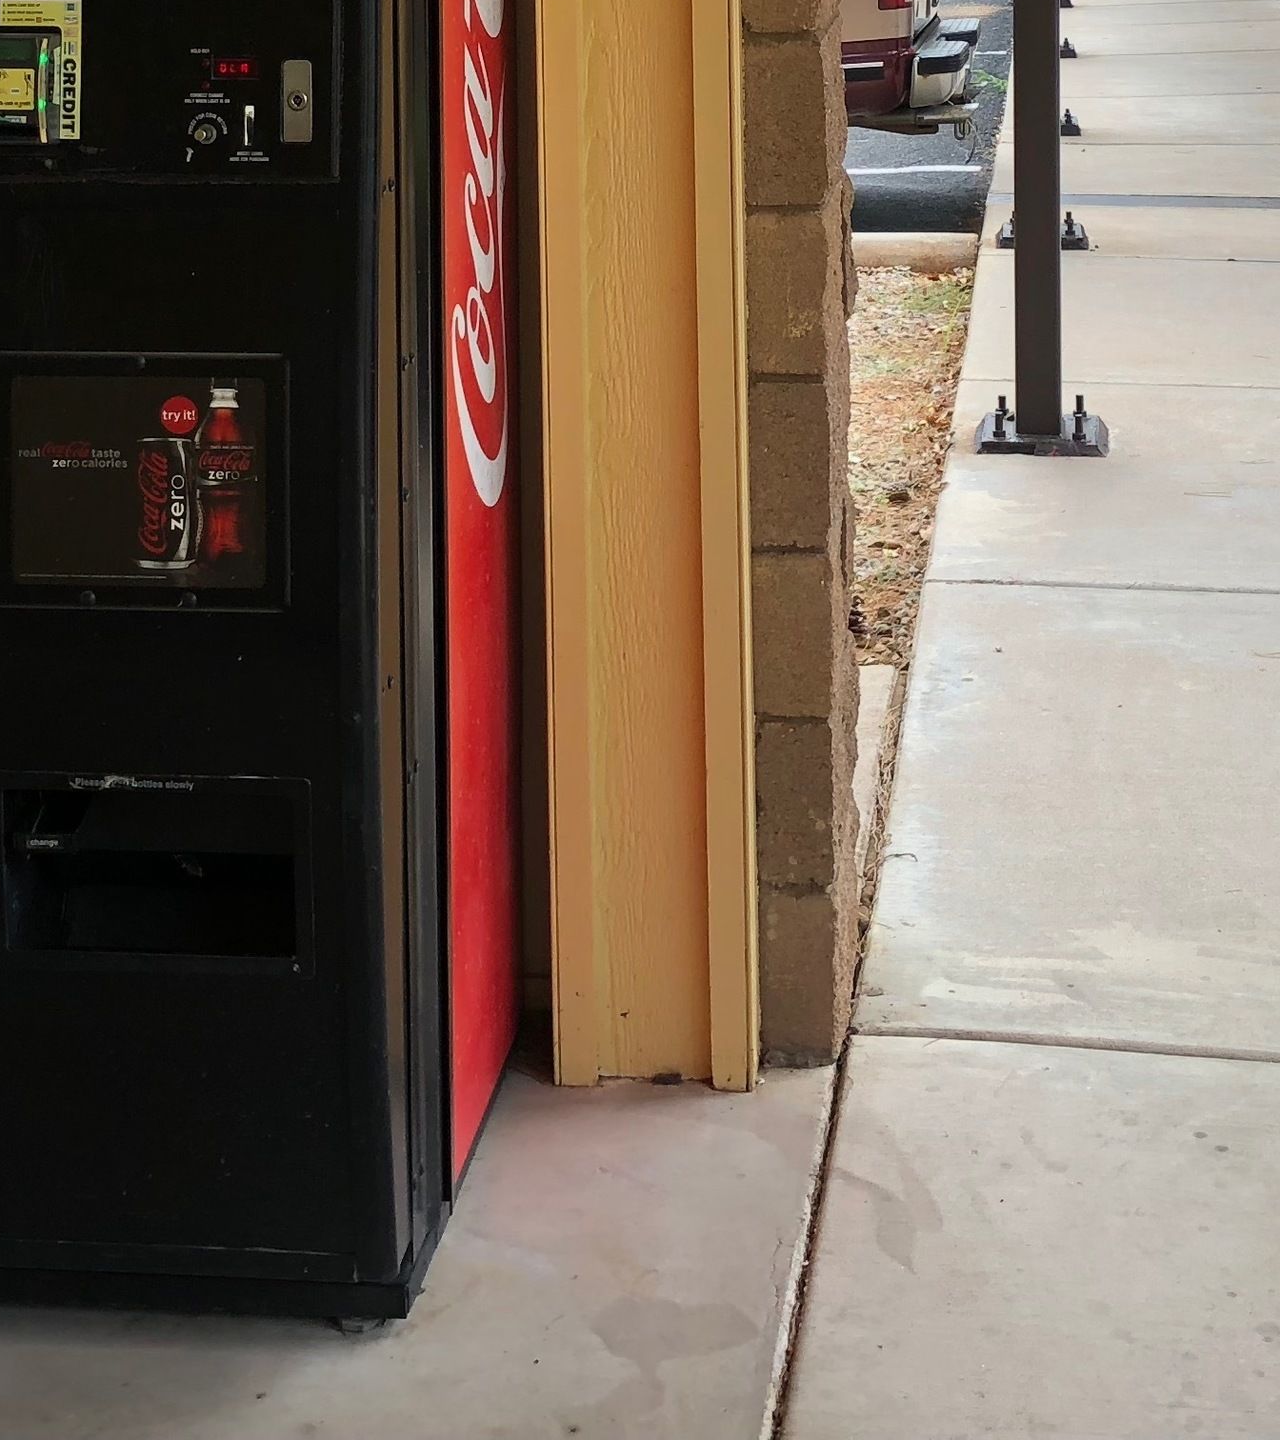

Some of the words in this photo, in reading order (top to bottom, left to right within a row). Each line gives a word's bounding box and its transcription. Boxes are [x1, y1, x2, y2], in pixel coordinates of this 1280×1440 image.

[62, 58, 77, 133] CREDIT
[162, 410, 180, 422] try
[183, 409, 196, 421] it!
[18, 447, 40, 458] real
[41, 441, 91, 458] Coca-Cola
[91, 448, 121, 458] taste
[51, 459, 80, 468] zero
[81, 459, 128, 469] calories
[199, 450, 252, 471] Coca-Cola
[208, 470, 240, 480] zero
[138, 449, 169, 556] Coca-Cola
[170, 474, 185, 531] zero
[165, 779, 194, 791] slowly
